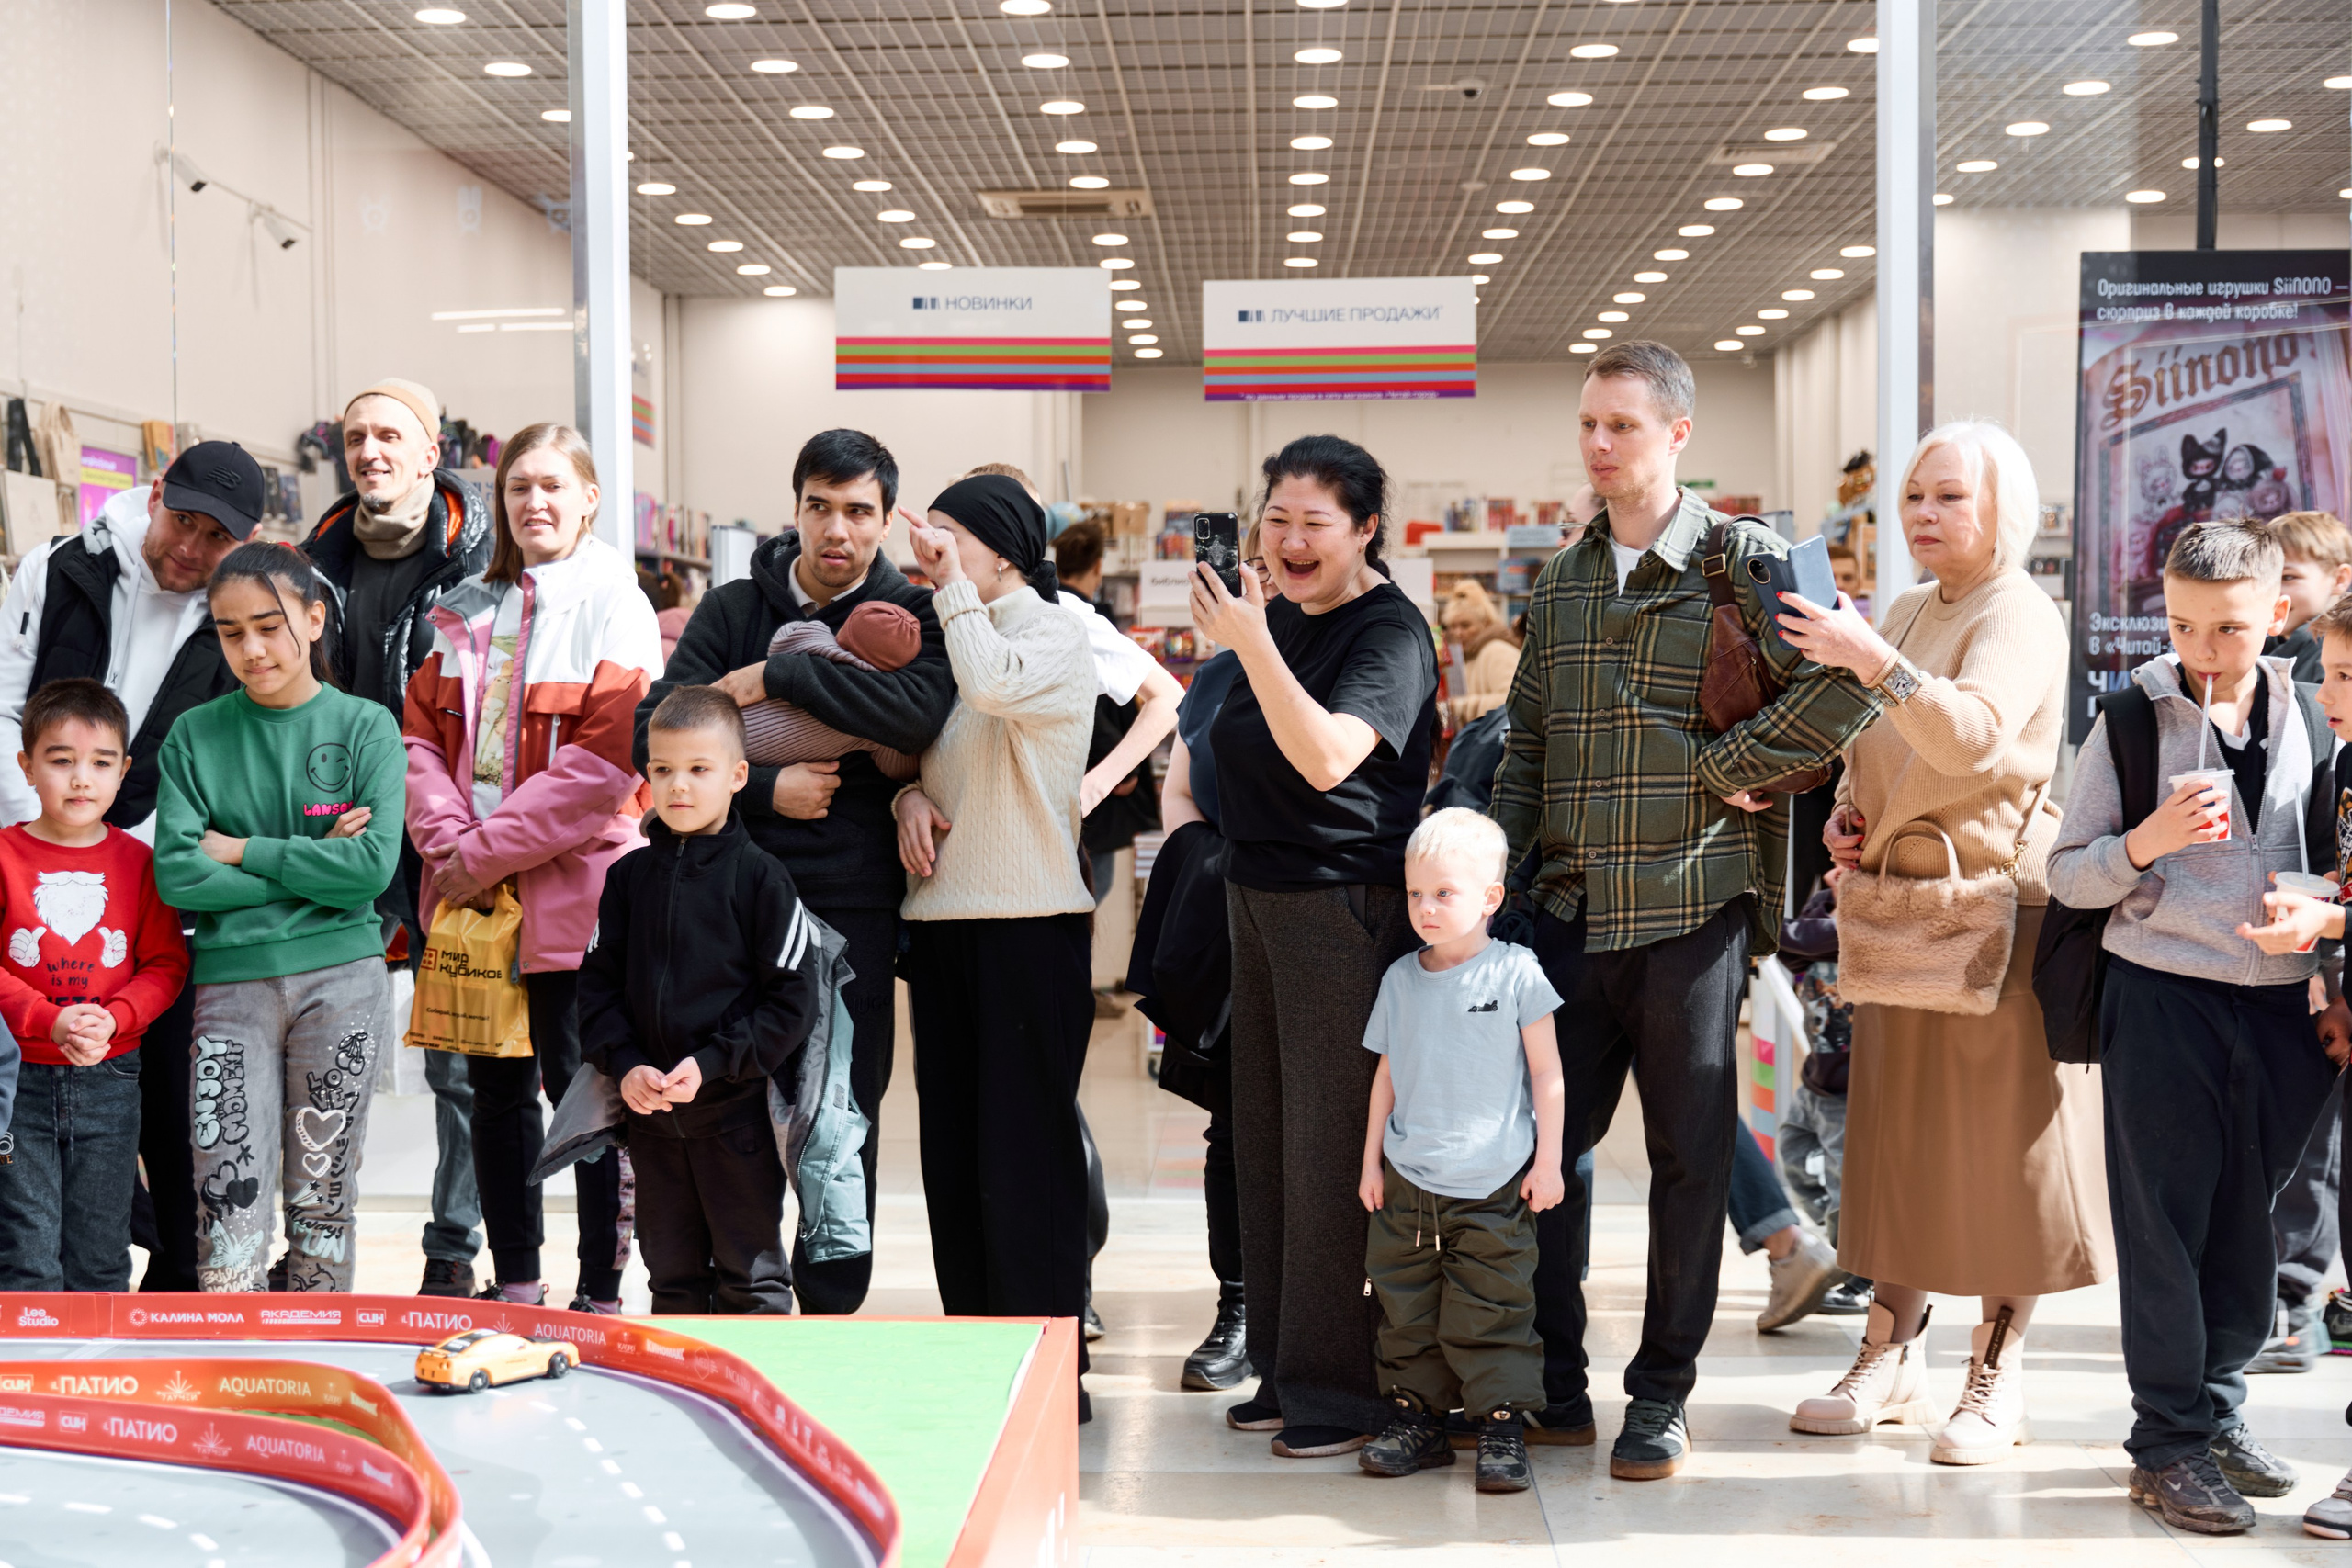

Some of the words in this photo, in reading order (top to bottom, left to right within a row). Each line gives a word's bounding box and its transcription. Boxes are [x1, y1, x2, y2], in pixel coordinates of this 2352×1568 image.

[2097, 278, 2203, 299] Оригинальные
[2208, 281, 2269, 299] игрушки
[945, 296, 1032, 310] НОВИНКИ
[1271, 308, 1346, 323] ЛУЧШИЕ
[2097, 306, 2160, 322] сюрприз
[2177, 302, 2231, 323] каждой
[2235, 303, 2298, 322] коробке!
[2089, 612, 2168, 632] Эксклюзи
[2087, 670, 2131, 693] ЧИ
[46, 956, 95, 973] where
[51, 974, 62, 986] is
[68, 976, 88, 990] my
[19, 1316, 59, 1326] Studio
[24, 1307, 47, 1317] Lee
[151, 1313, 204, 1323] КАЛИНА
[208, 1313, 244, 1323] МОЛЛ
[261, 1309, 341, 1319] АКАДЕМИЯ
[409, 1311, 472, 1331] ПАТИО
[61, 1376, 139, 1395] ПАТИО
[220, 1377, 311, 1397] AQUATORIA
[0, 1406, 45, 1420] ДЕМИЯ
[110, 1417, 178, 1443] ПАТИО
[247, 1435, 326, 1463] AQUATORIA
